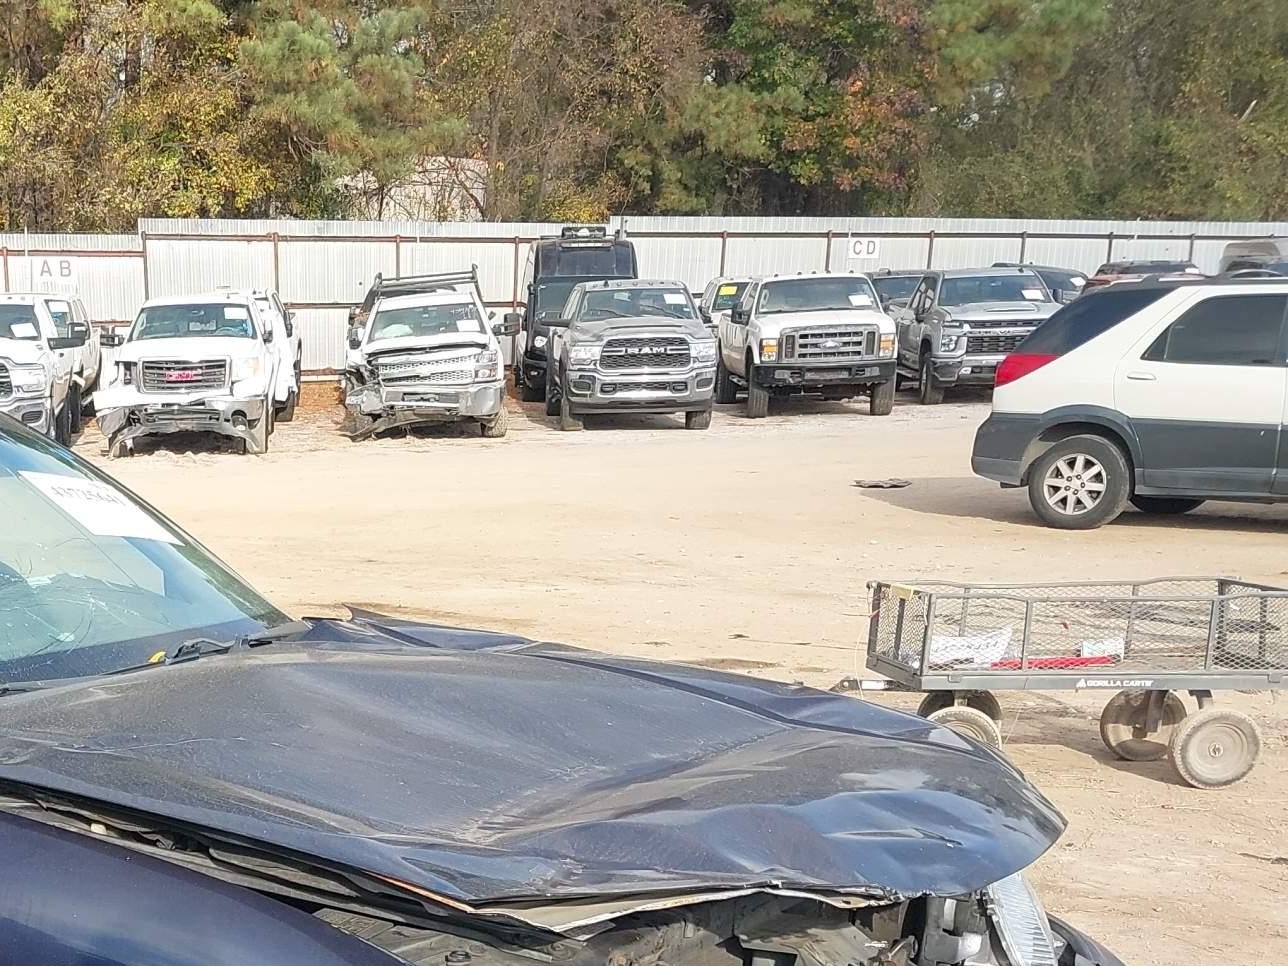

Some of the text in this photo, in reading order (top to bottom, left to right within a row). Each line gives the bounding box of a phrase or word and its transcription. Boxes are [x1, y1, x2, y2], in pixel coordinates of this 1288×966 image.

[853, 240, 876, 255] C D
[40, 259, 71, 277] A B
[627, 347, 665, 355] RAM
